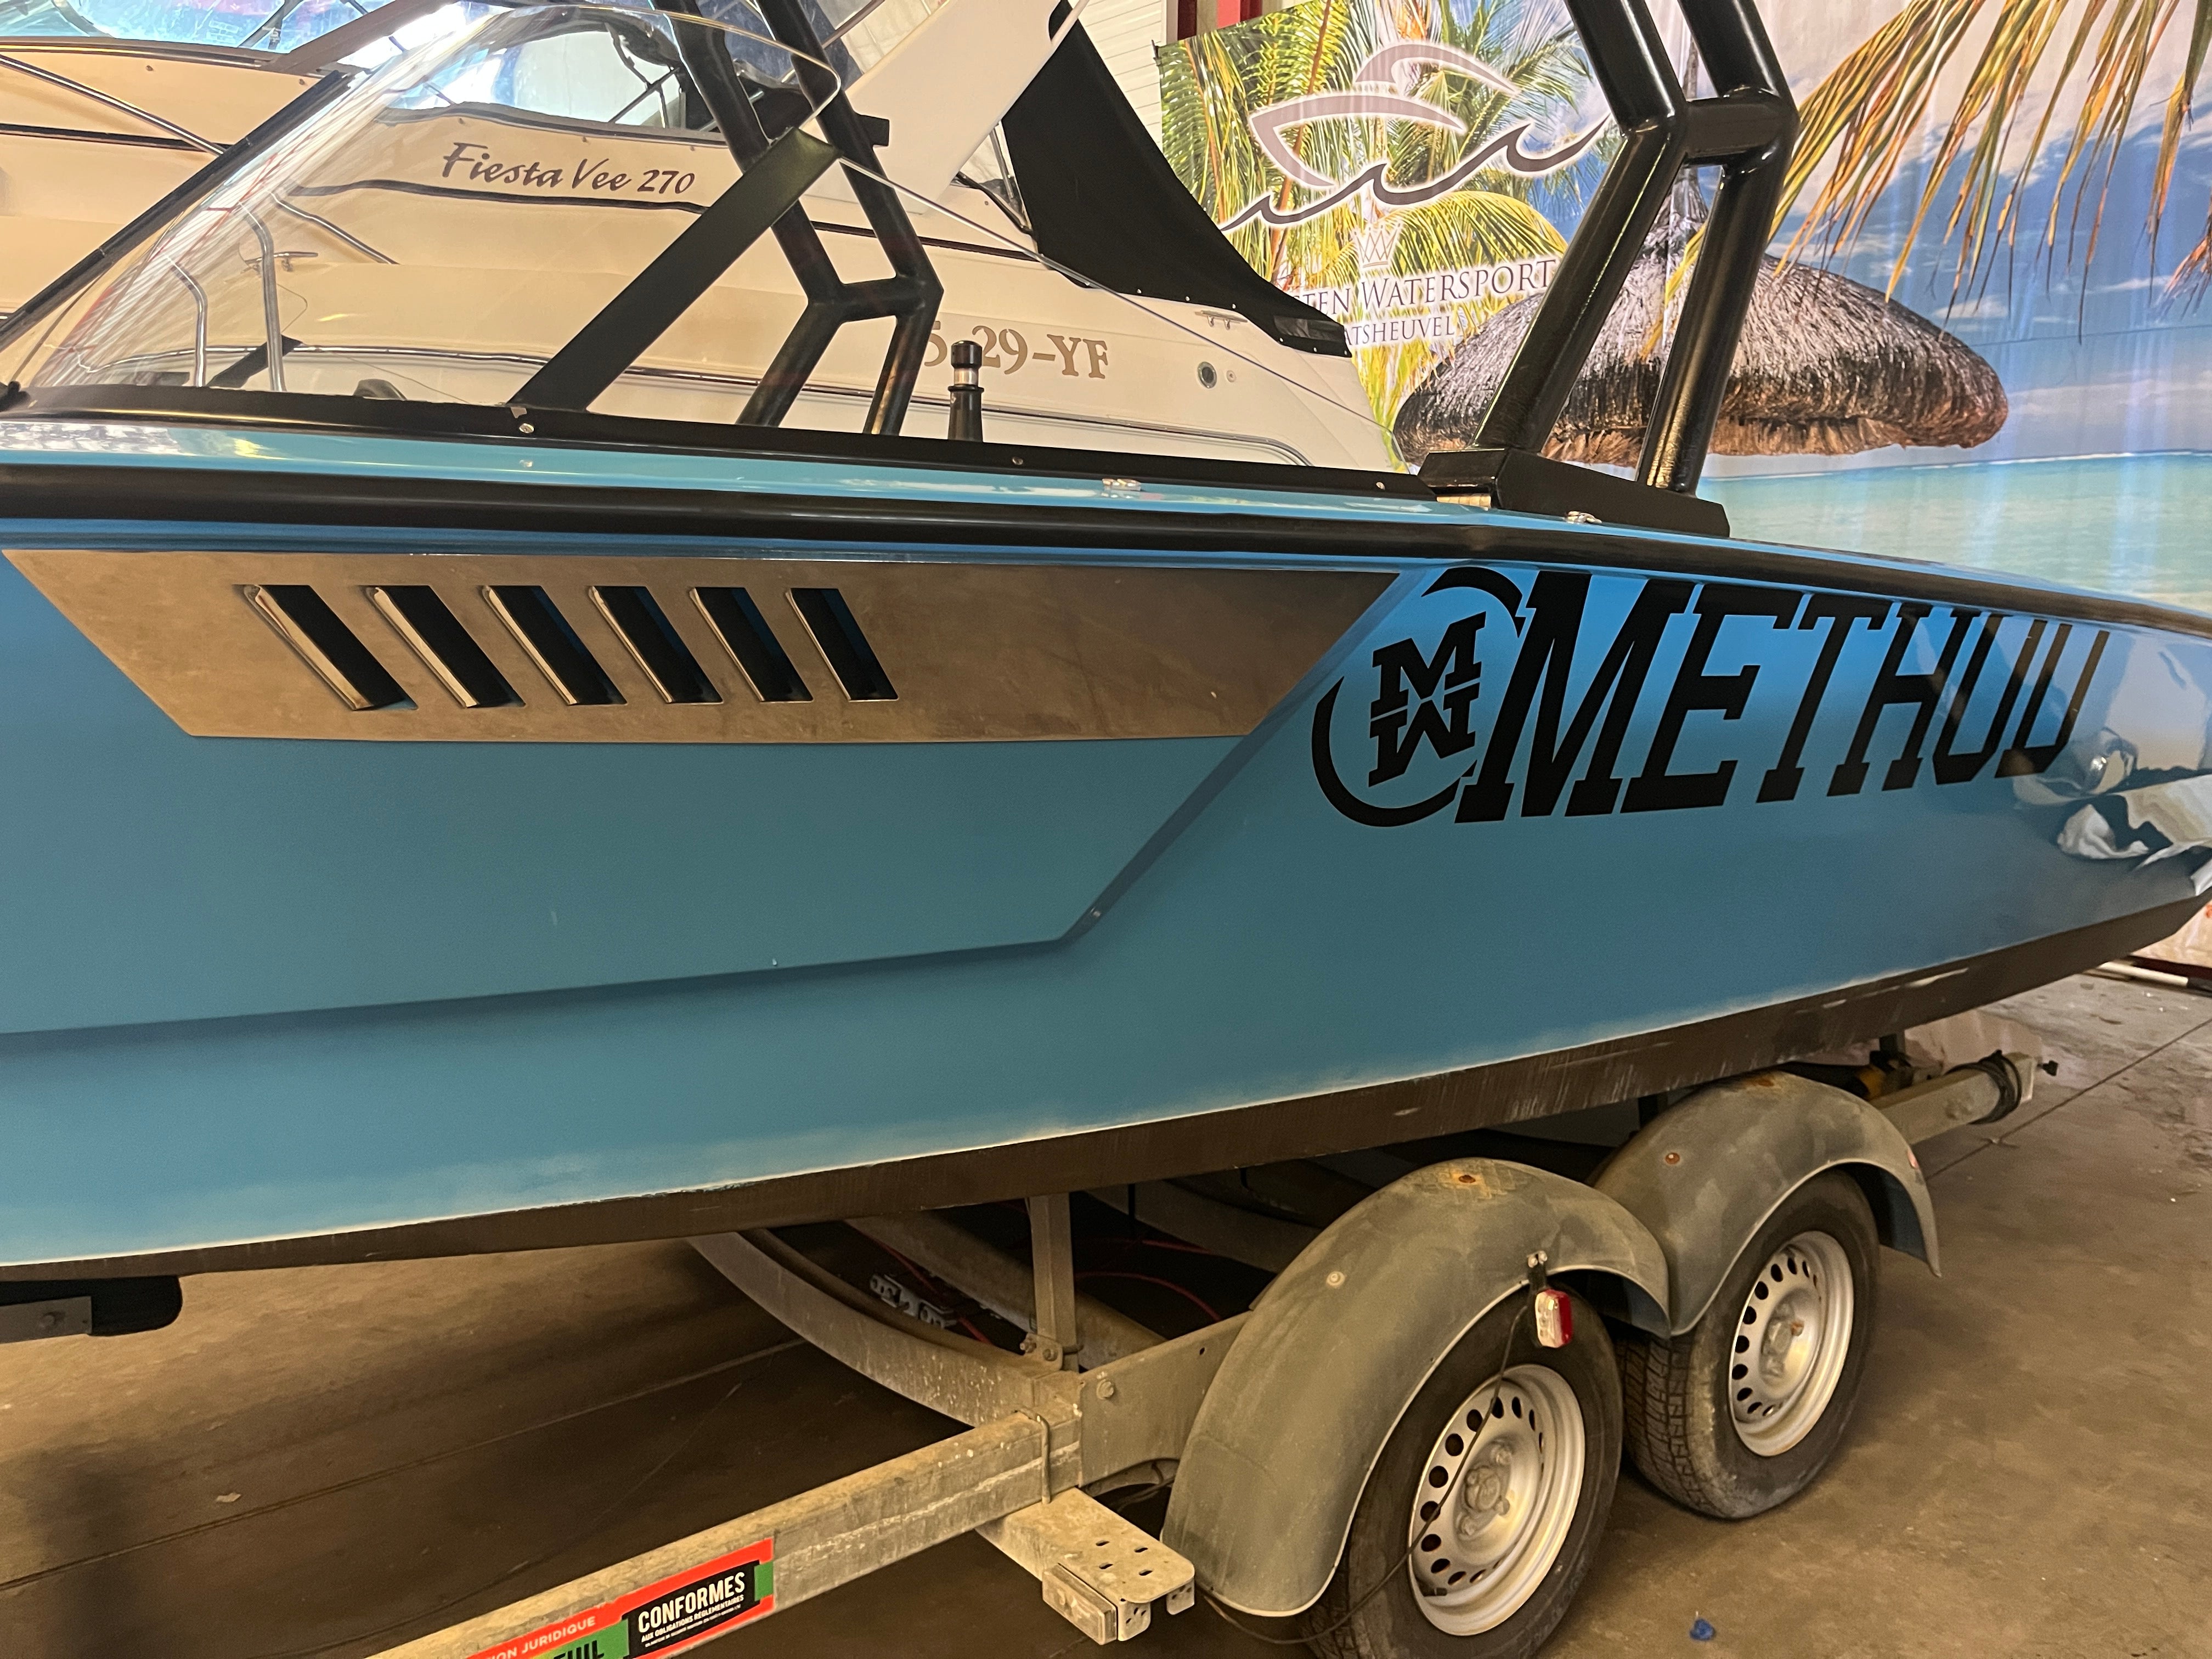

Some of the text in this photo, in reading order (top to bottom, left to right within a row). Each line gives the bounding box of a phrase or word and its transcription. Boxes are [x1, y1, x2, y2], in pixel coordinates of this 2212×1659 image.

[442, 142, 695, 194] Fiesta Vee 270
[1294, 288, 1351, 315] TEN
[924, 320, 1108, 380] 529-YF
[638, 1572, 745, 1633] CONFORMES
[522, 1616, 596, 1654] JURIDIQUE
[641, 1632, 654, 1643] AUX
[654, 1615, 693, 1637] OBLIGATIONS
